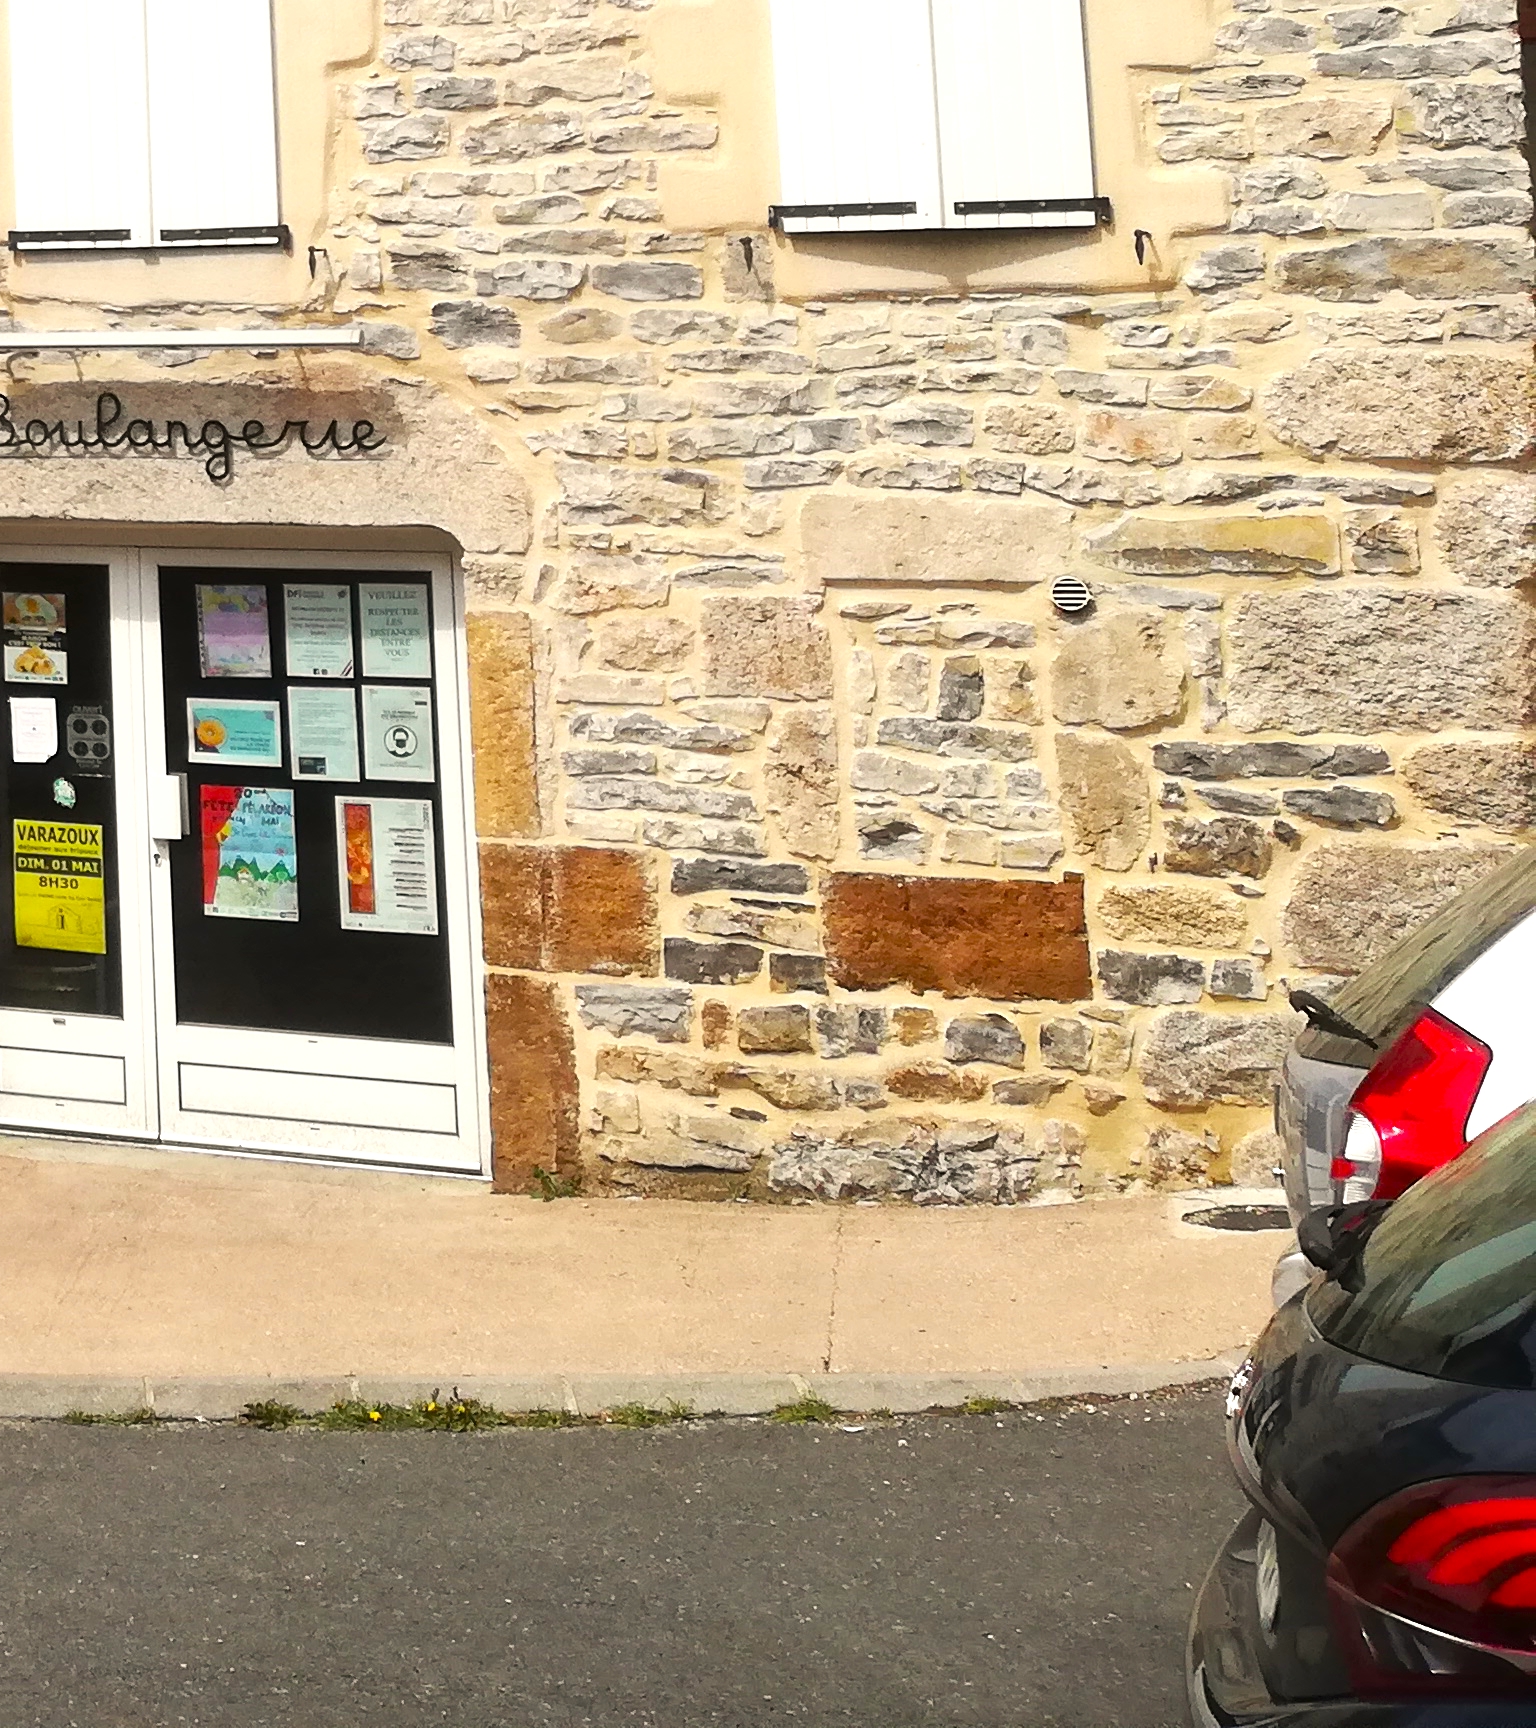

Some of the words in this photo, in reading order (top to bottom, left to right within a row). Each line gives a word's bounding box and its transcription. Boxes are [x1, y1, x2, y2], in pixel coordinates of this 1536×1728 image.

[17, 824, 99, 846] VARAZOUX
[18, 857, 49, 870] DIM.
[52, 860, 67, 871] 01
[71, 861, 98, 873] MAI
[39, 876, 78, 889] 8H30
